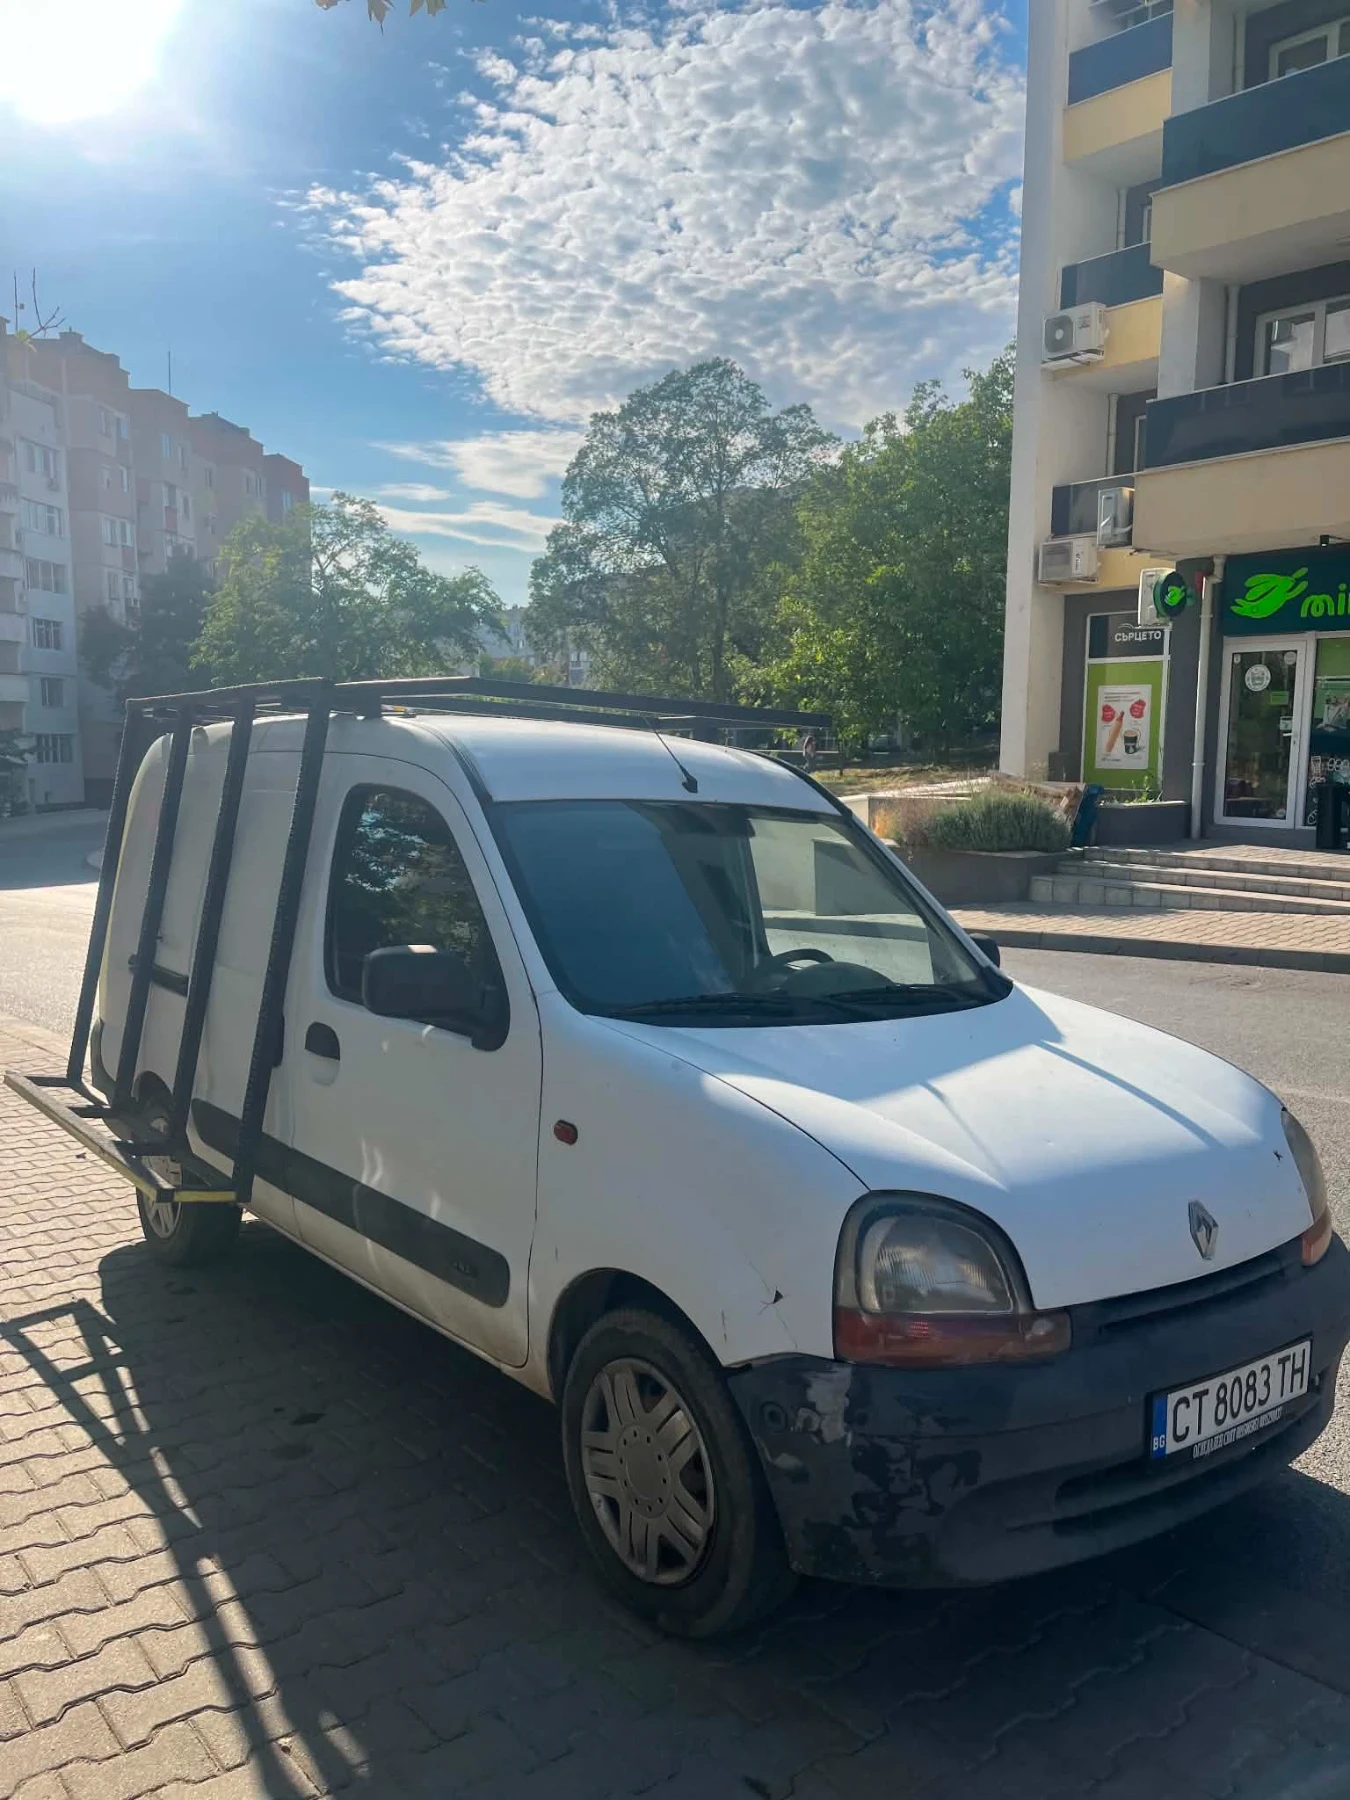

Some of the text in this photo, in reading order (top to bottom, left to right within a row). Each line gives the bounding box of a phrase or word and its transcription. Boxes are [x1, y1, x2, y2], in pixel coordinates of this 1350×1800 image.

[1114, 630, 1162, 642] СЪРЦЕТО
[1172, 1389, 1209, 1443] CT
[1214, 1364, 1271, 1427] 8083
[1277, 1349, 1306, 1399] TH
[1153, 1434, 1166, 1451] BG
